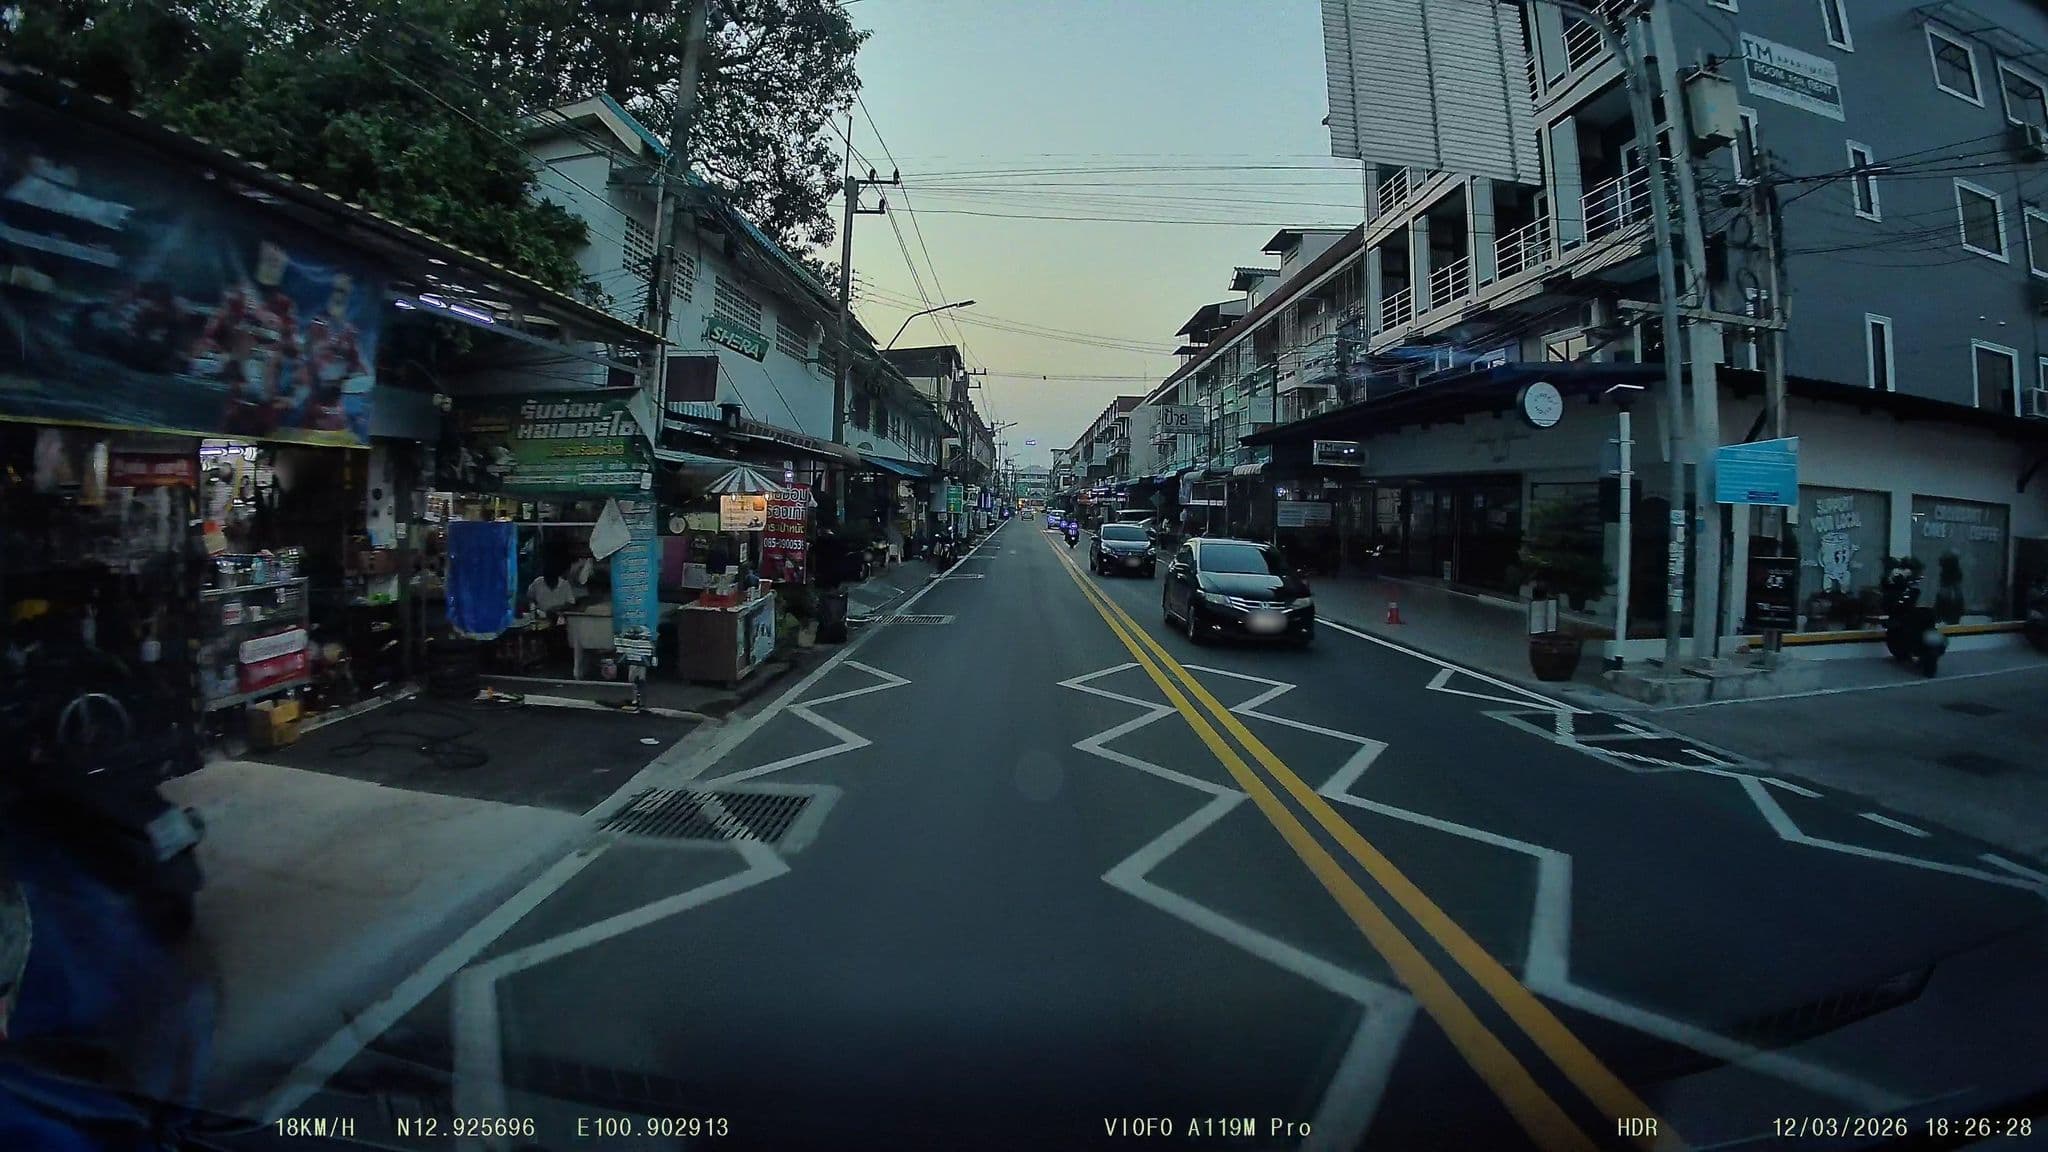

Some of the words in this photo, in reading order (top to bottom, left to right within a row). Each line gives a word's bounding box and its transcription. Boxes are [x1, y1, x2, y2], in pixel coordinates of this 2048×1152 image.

[1743, 39, 1773, 63] TM
[1754, 62, 1785, 81] ROOM
[711, 326, 760, 358] SHERA
[1163, 406, 1188, 426] ป้าย
